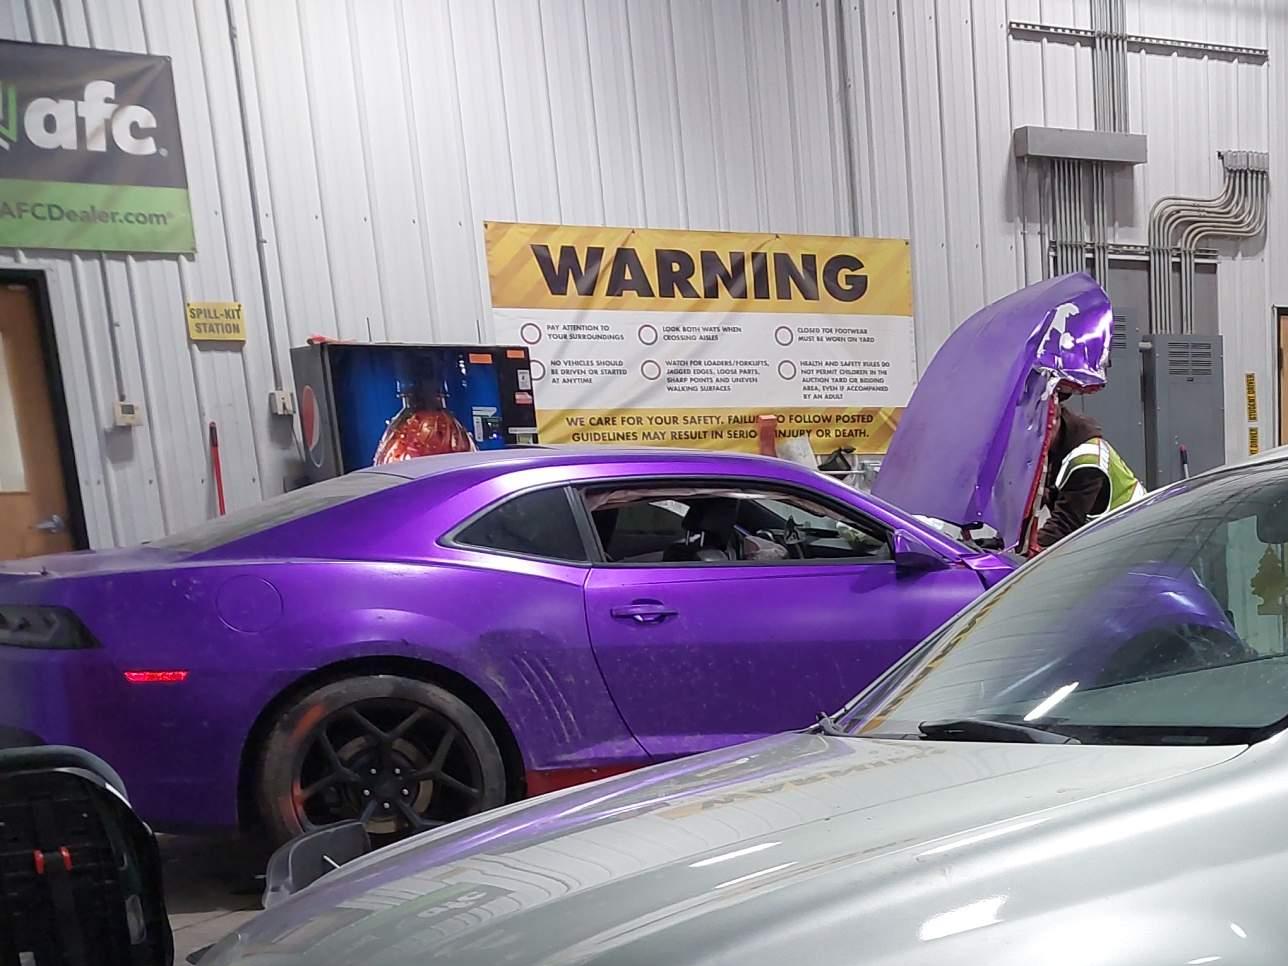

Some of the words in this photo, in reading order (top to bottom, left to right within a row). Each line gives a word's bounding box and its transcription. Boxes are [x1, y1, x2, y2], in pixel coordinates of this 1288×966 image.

[530, 244, 868, 302] WARNING
[189, 307, 241, 319] SPILL-KIT
[195, 322, 240, 333] STATION
[566, 417, 585, 426] WE
[588, 416, 617, 426] CARE
[621, 416, 644, 426] FOR
[646, 415, 680, 426] YOUR
[682, 415, 725, 425] SAFETY.
[728, 415, 760, 424] FAILU
[789, 414, 832, 424] FOLLOW
[835, 414, 874, 423] POSTED
[572, 431, 638, 442] GUIDELINES
[641, 431, 666, 441] MAY
[671, 430, 707, 440] RESULT
[711, 430, 723, 439] IN
[727, 429, 758, 439] SERIO
[815, 429, 831, 438] OR
[834, 429, 870, 438] DEATH.
